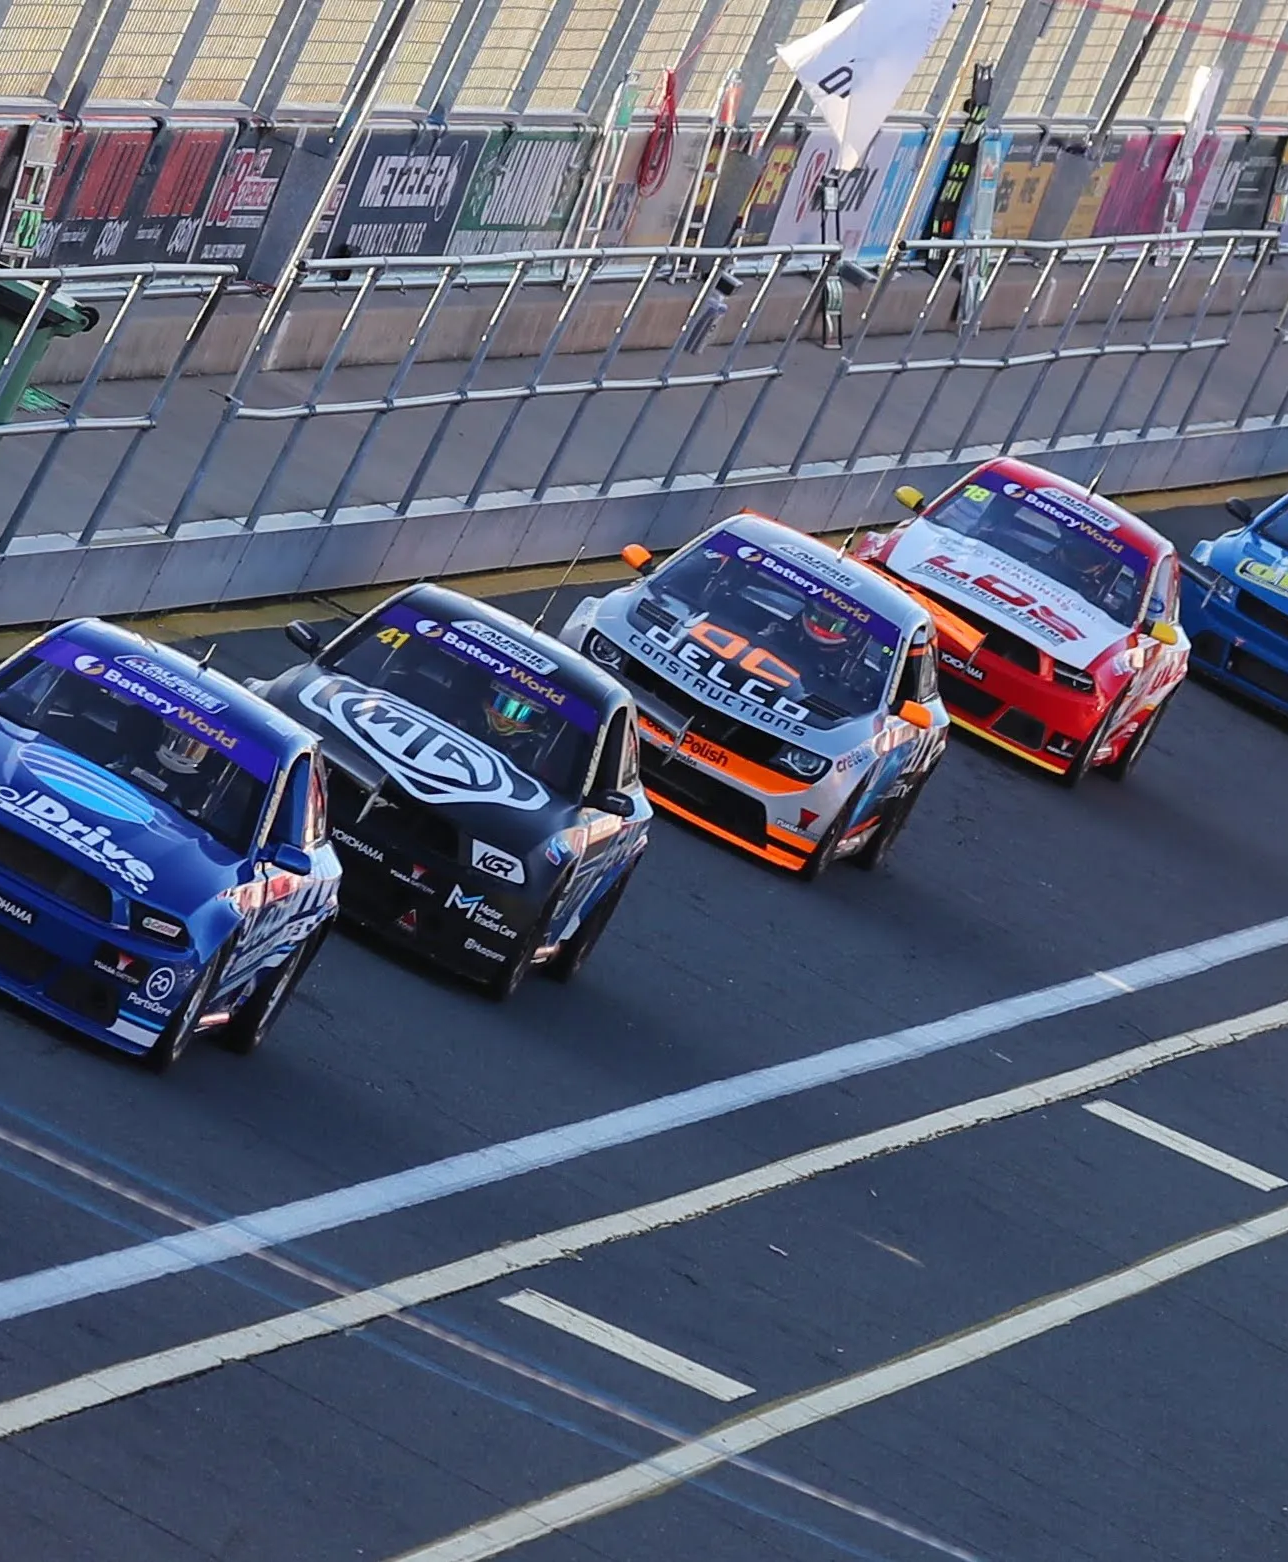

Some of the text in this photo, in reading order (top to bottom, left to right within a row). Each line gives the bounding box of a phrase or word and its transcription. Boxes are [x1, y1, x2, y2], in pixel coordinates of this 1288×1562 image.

[359, 155, 453, 207] METZELER
[964, 484, 992, 502] 18
[376, 626, 411, 650] 41
[628, 633, 806, 738] CONSTRUCTIONS
[645, 625, 810, 721] DELCO
[682, 732, 728, 768] Polish
[331, 826, 385, 863] YOKOHAMA
